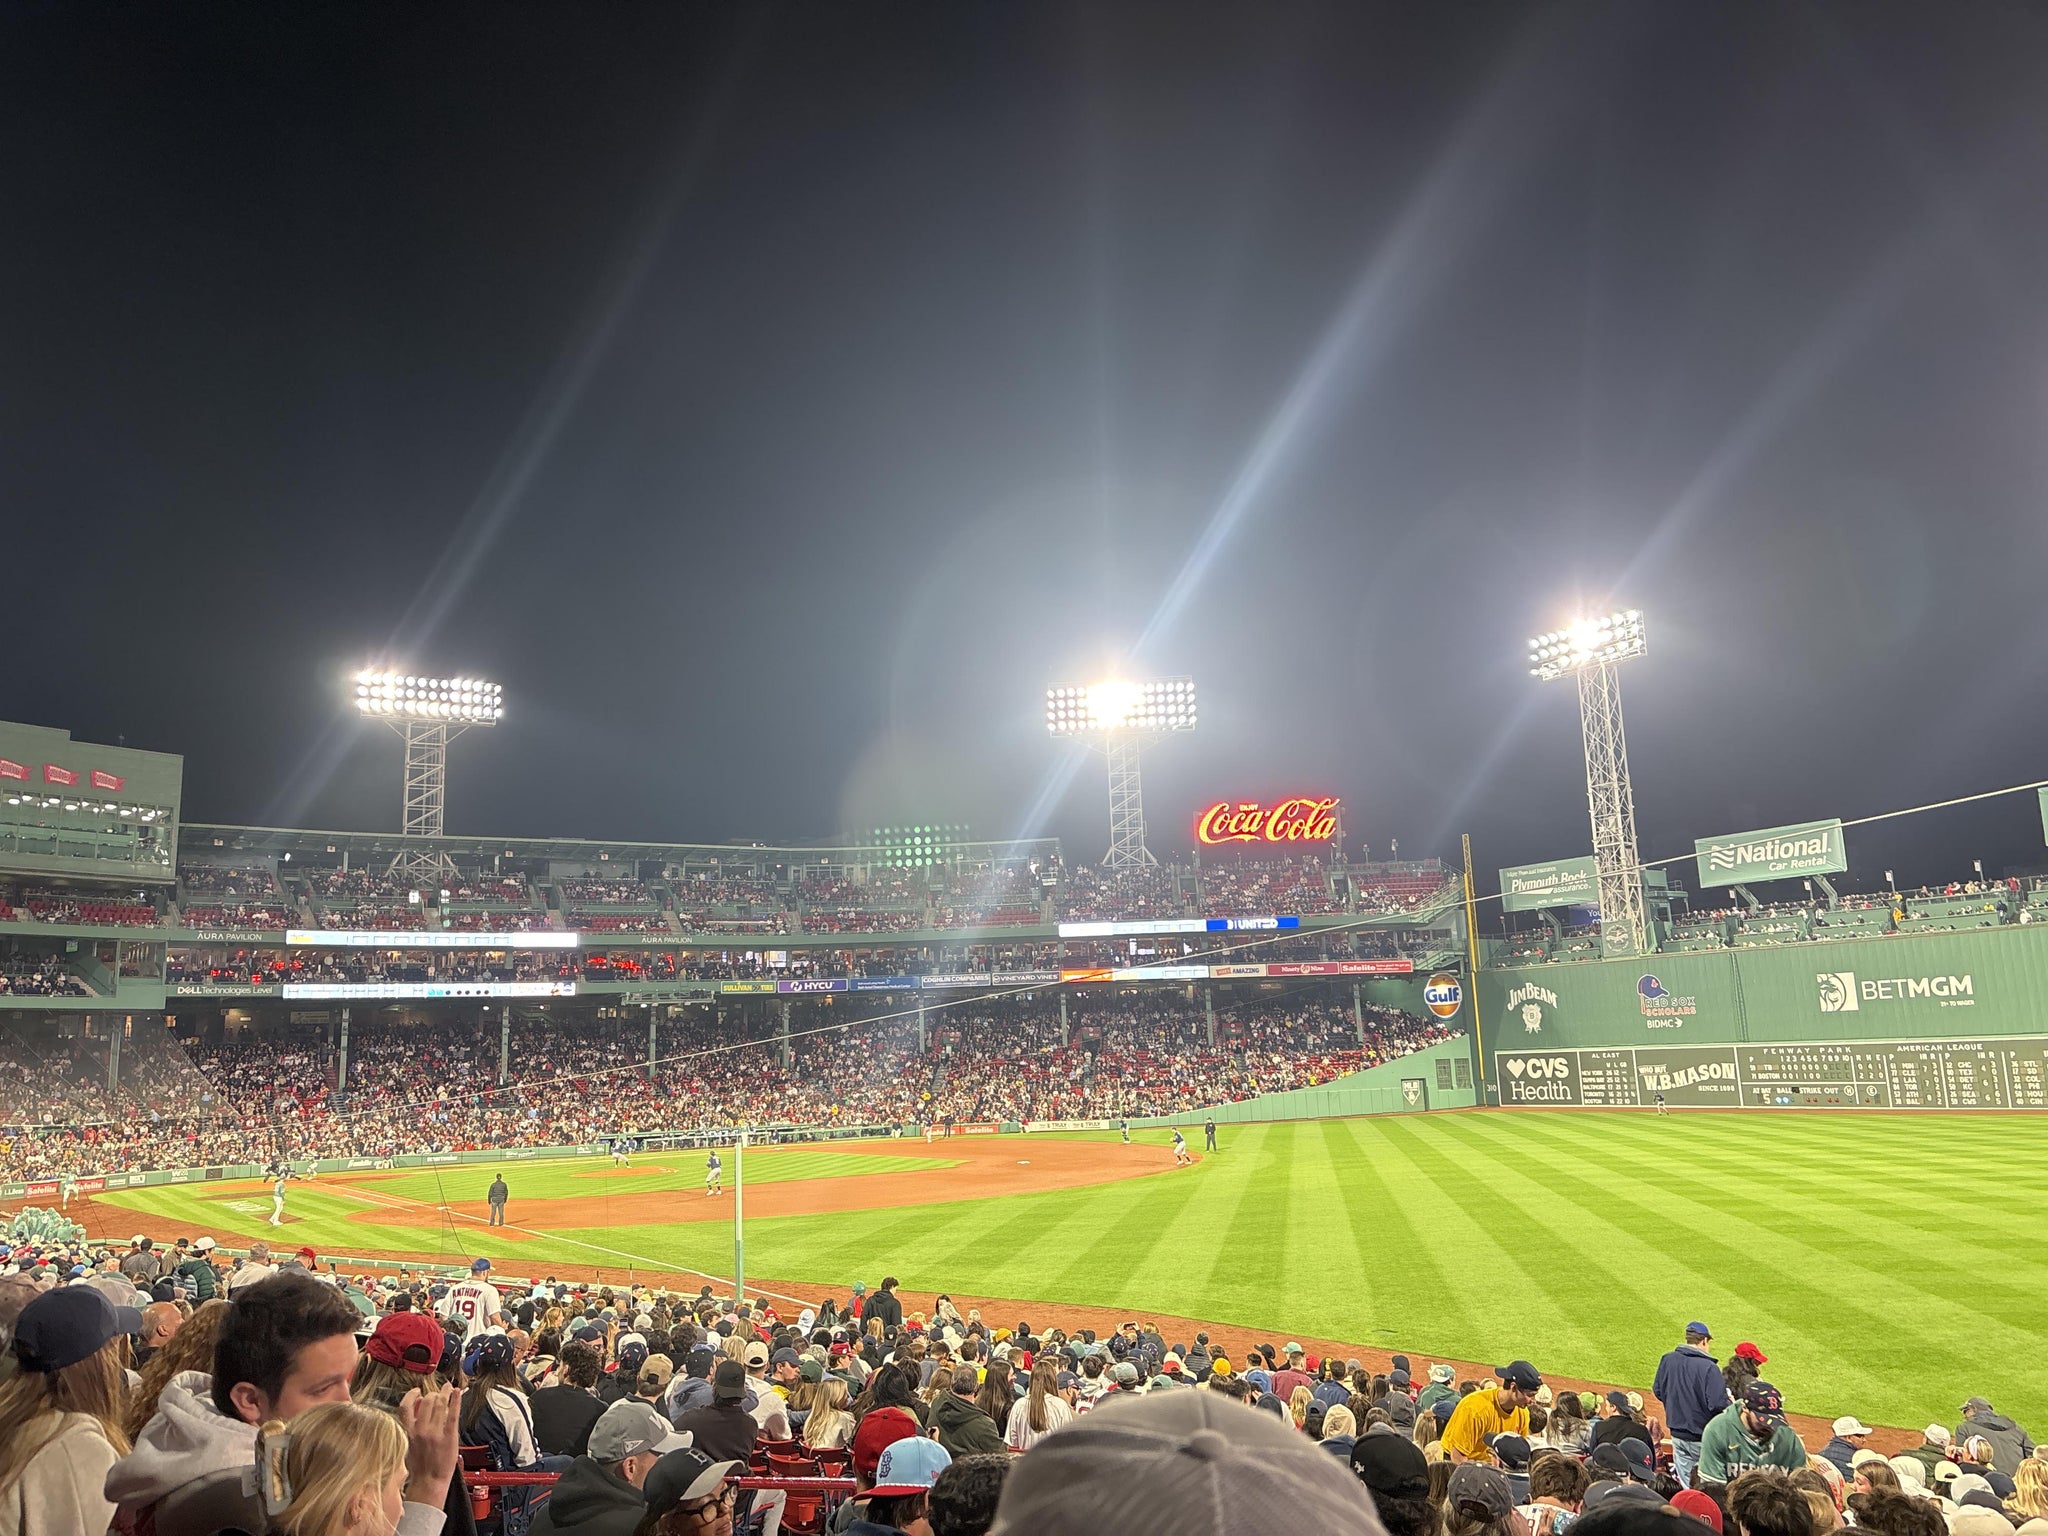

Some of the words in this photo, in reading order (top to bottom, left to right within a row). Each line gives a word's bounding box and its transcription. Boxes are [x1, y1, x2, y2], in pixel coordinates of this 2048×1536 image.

[1199, 798, 1340, 844] Coca-Cola
[1769, 861, 1787, 871] Car
[1791, 856, 1826, 869] Rental
[1512, 874, 1558, 892] Plymouth
[663, 936, 693, 944] PAVILION
[1342, 964, 1376, 972] Safelite
[177, 986, 202, 994] DELL
[202, 986, 252, 996] Technologies
[253, 986, 273, 994] Level
[804, 982, 833, 990] HYCU
[1861, 974, 1974, 1000] BETMGM
[1425, 987, 1459, 1003] Gulf
[1645, 997, 1669, 1008] RED
[1671, 996, 1696, 1006] SOX
[1646, 1006, 1697, 1016] SCHOLARS
[1646, 1019, 1674, 1029] BIDMC
[1763, 1047, 1810, 1055] FENWAY
[1896, 1044, 1943, 1052] AMERICAN
[1947, 1043, 1983, 1051] LEAGUE
[1526, 1057, 1569, 1079] CVS
[1486, 1084, 1497, 1092] 310
[1510, 1080, 1572, 1100] Health
[27, 1186, 57, 1195] Safelite
[452, 1287, 483, 1299] ANTHONY
[455, 1300, 475, 1320] 19
[1767, 1396, 1778, 1409] B
